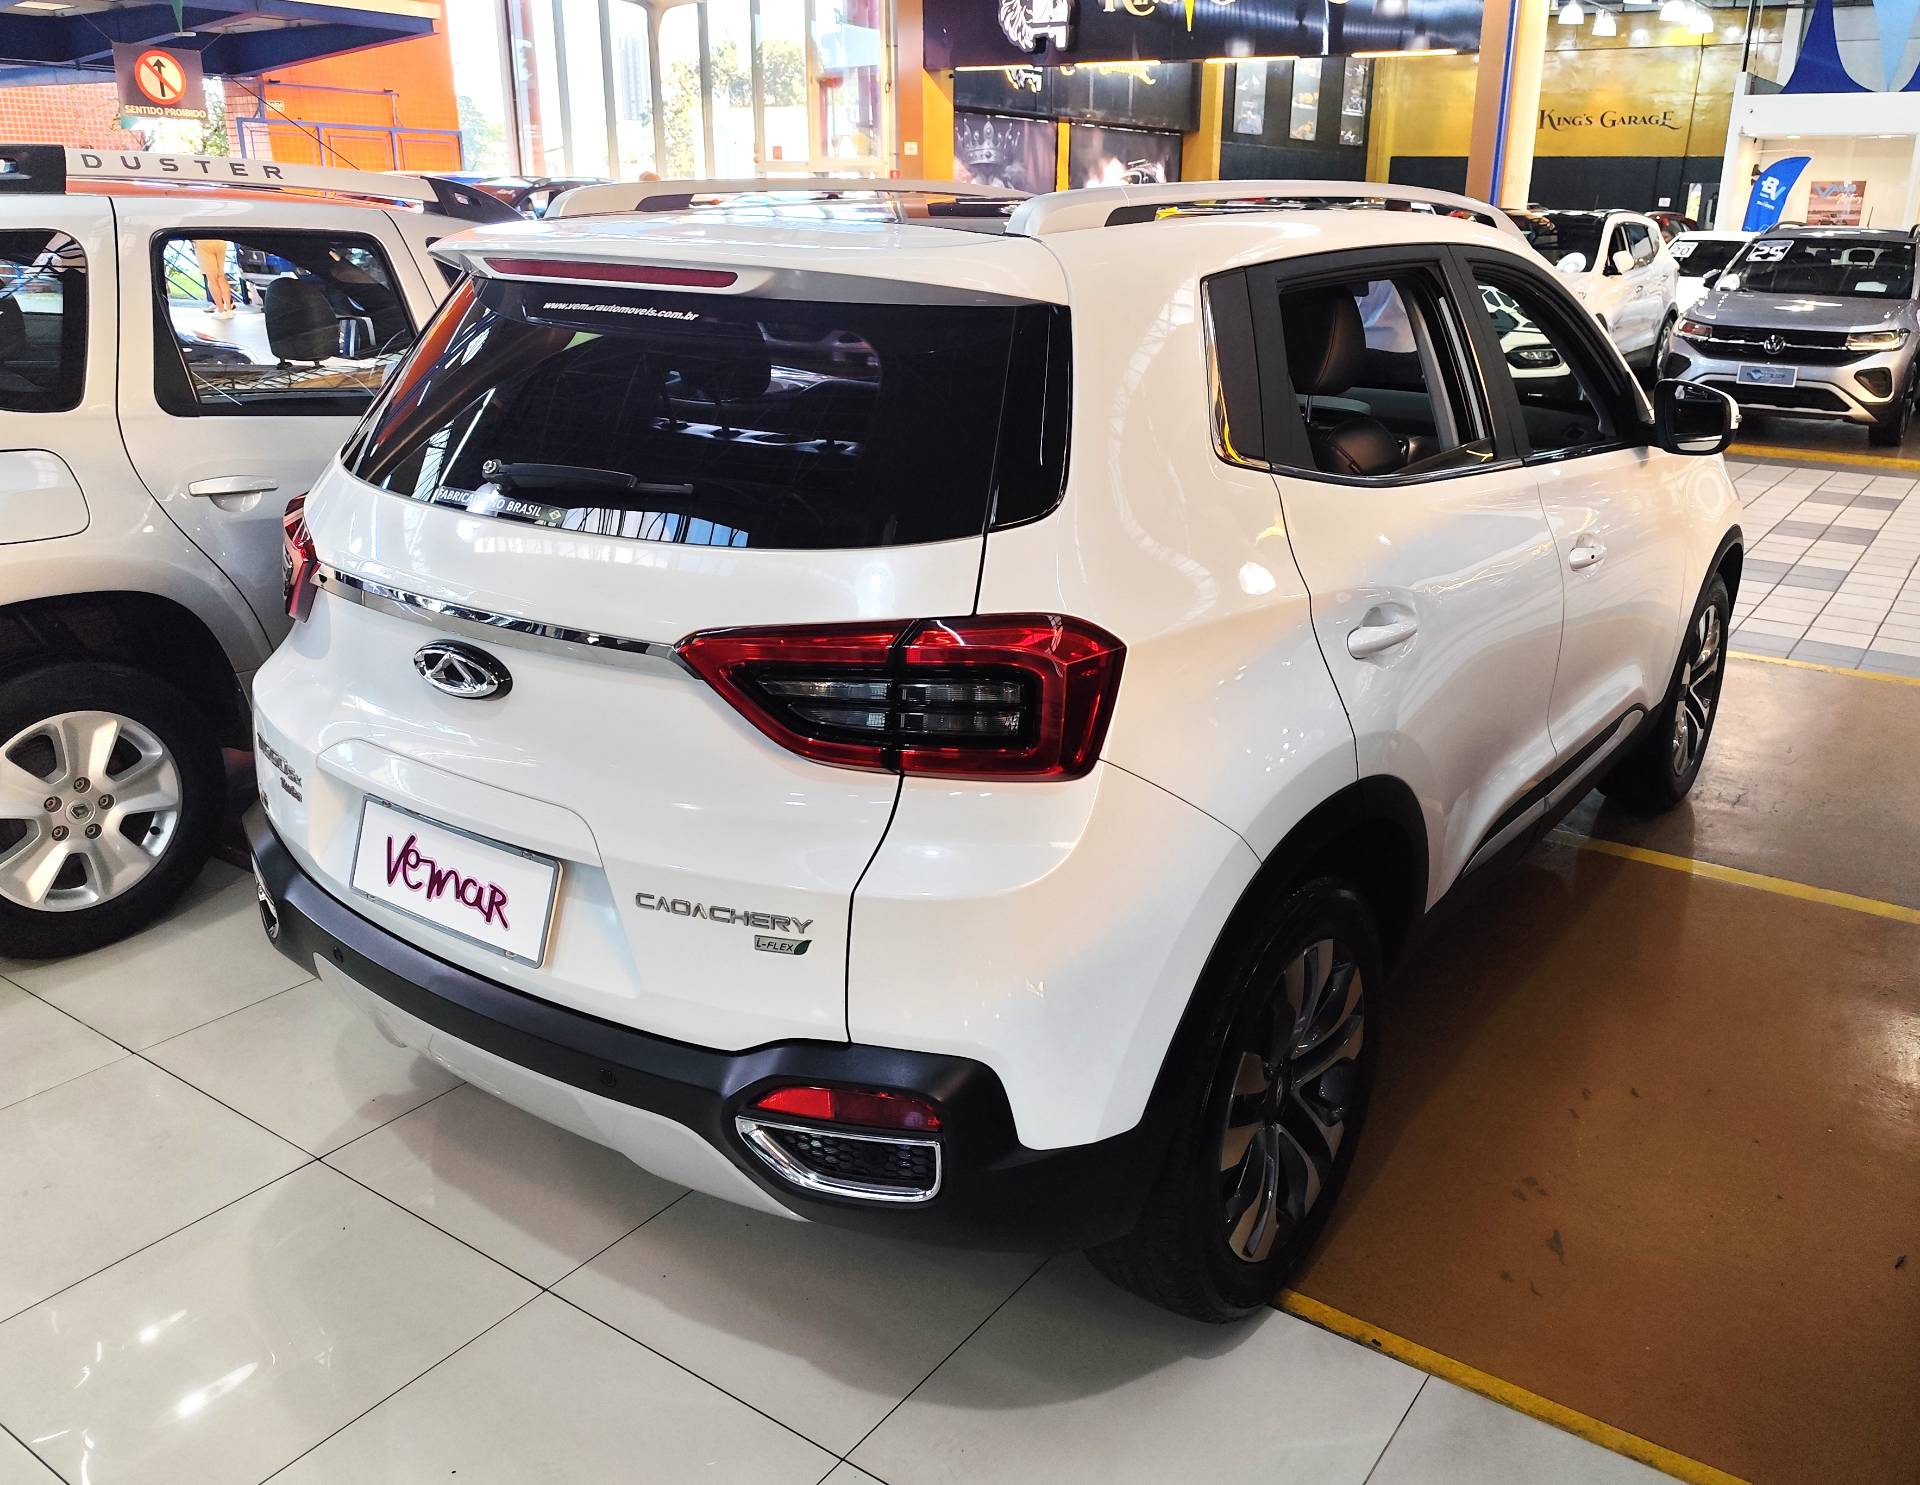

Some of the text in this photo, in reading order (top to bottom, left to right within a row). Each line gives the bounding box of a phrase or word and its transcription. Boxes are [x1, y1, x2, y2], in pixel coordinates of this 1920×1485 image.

[124, 105, 207, 119] SENTIDO PROIBIDO
[1538, 108, 1682, 131] KING'S GARAGE
[81, 153, 284, 180] DUSTER
[543, 301, 700, 321] www.vemarautomoveis.com.br
[437, 486, 487, 508] FABRICAD
[506, 500, 542, 518] BRASIL
